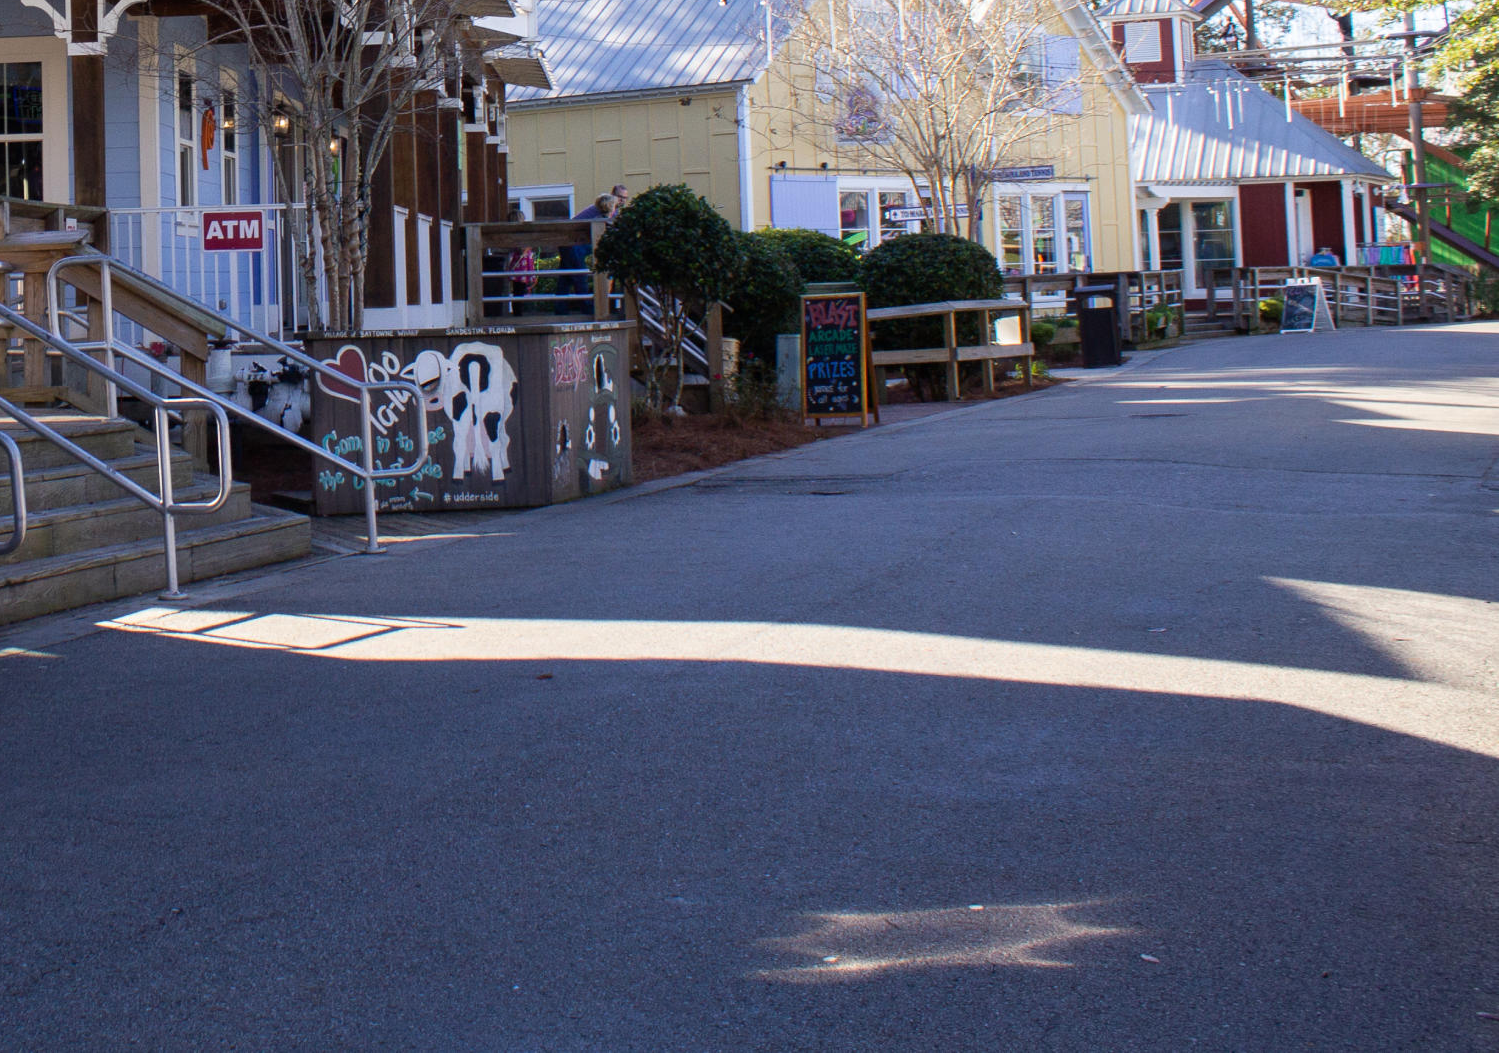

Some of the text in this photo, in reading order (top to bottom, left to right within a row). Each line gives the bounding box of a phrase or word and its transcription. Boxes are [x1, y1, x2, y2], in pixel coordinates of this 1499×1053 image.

[206, 219, 260, 240] ATM
[808, 300, 859, 329] BLAST
[808, 330, 853, 343] ARCADE
[808, 361, 855, 379] PRIZES
[322, 426, 446, 456] Com in to ee
